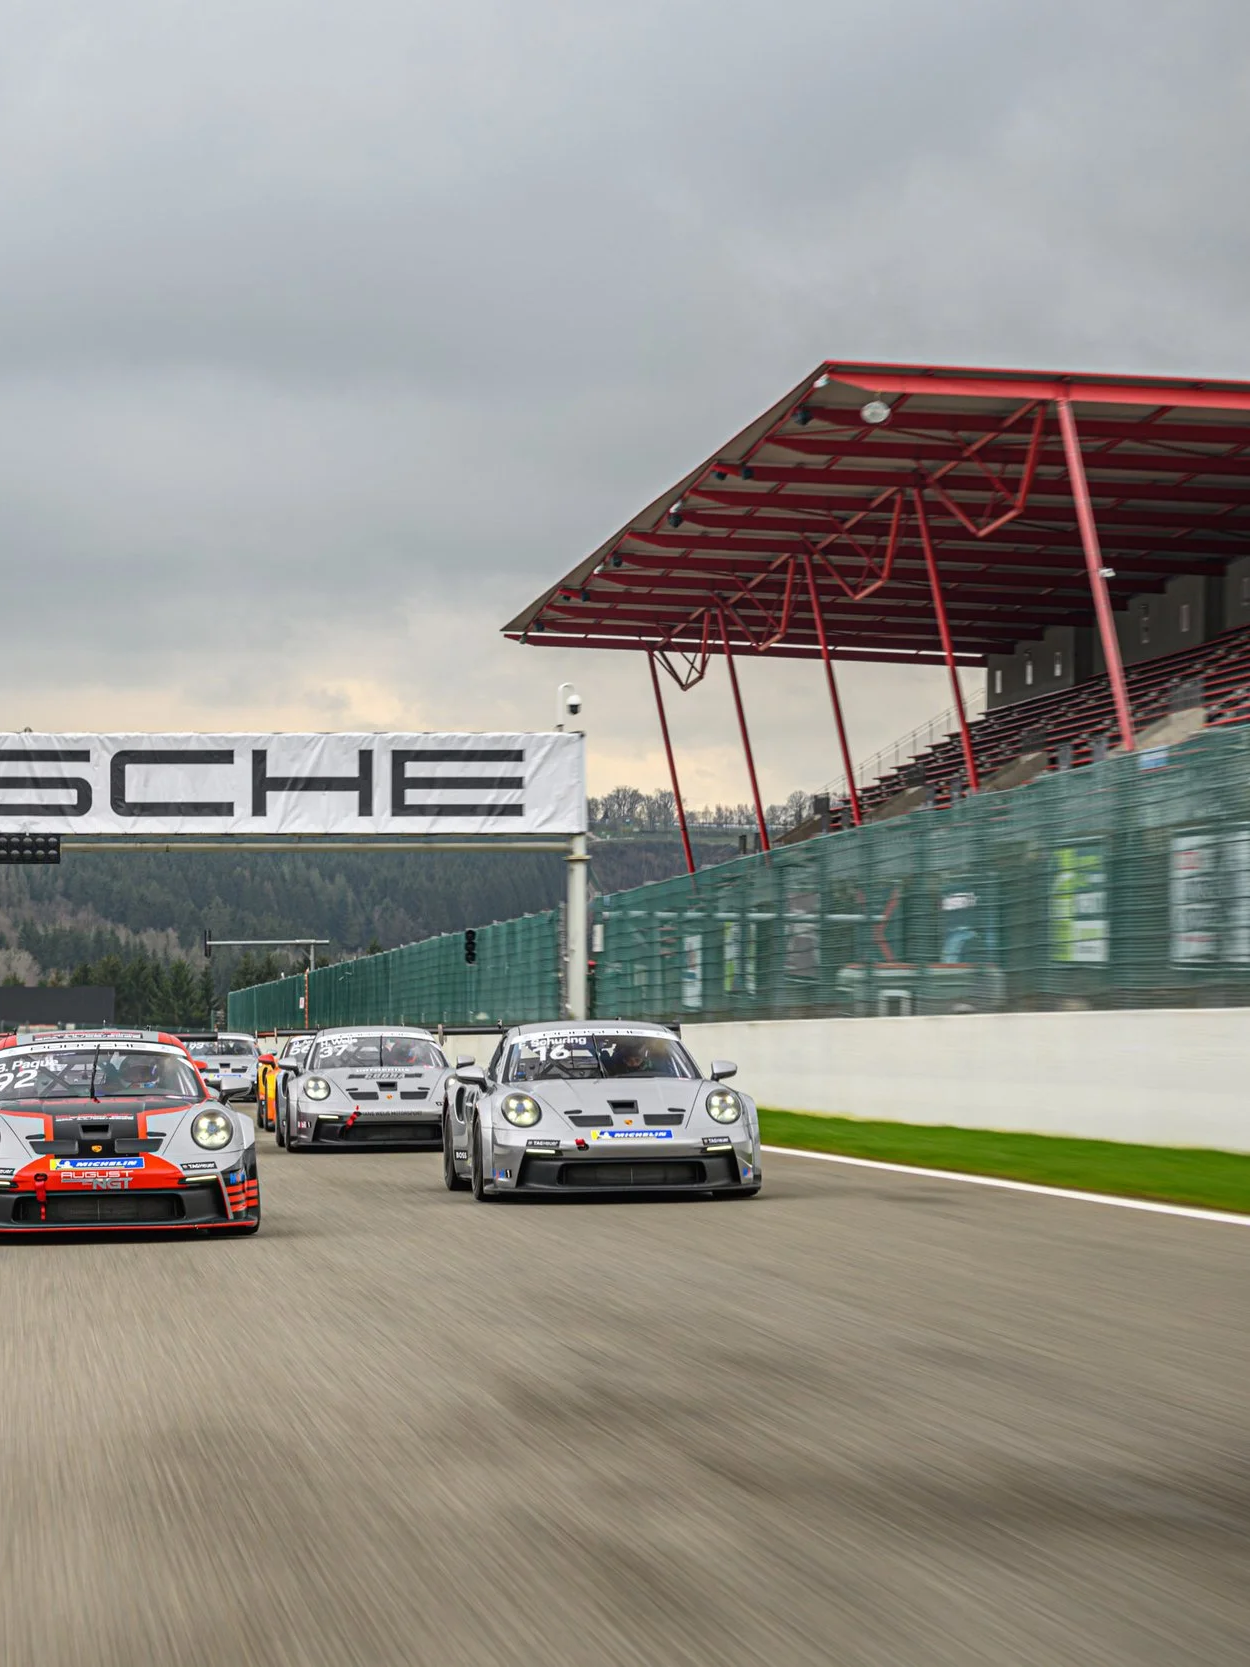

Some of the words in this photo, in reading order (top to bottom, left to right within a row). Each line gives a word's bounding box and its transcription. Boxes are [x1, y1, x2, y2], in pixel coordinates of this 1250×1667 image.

[531, 1036, 586, 1047] Schuring
[319, 1044, 348, 1058] 37
[532, 1044, 570, 1061] 16
[455, 1151, 468, 1159] BOSS
[61, 1170, 134, 1179] AUGUST
